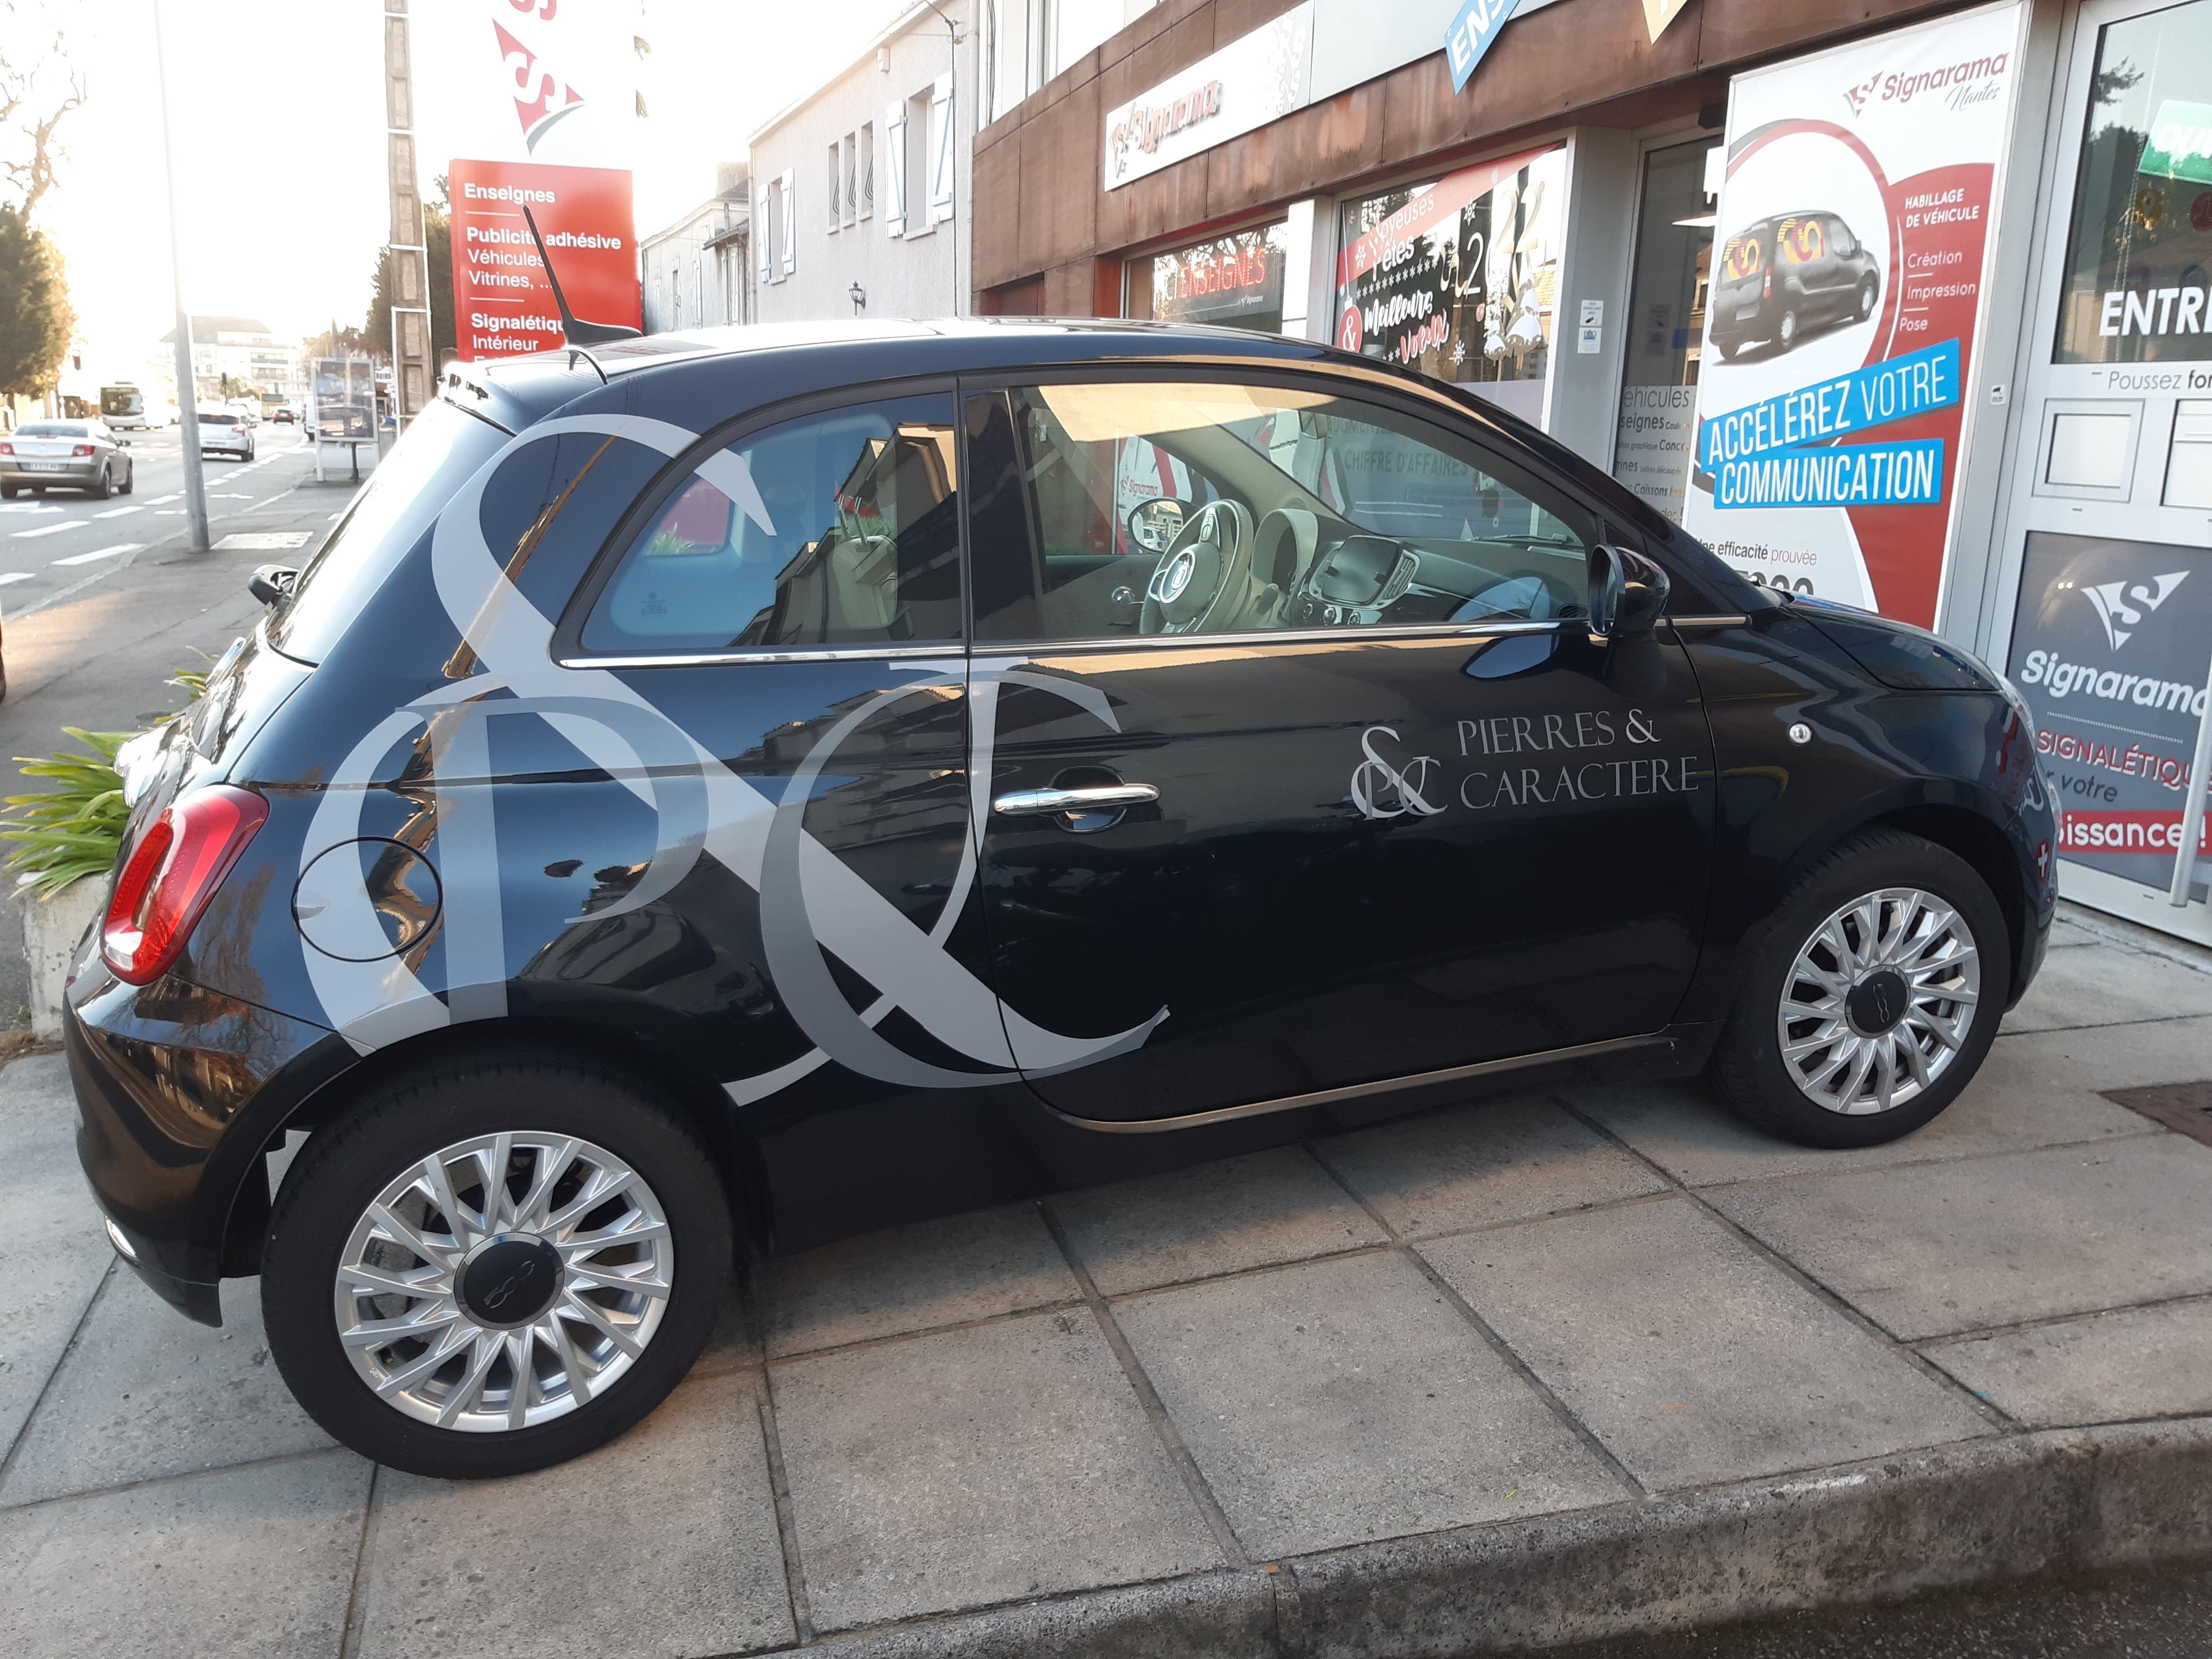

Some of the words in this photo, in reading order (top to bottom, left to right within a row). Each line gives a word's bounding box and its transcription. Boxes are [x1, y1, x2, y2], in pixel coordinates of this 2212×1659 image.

[1882, 52, 2009, 103] Signarama
[1945, 80, 2000, 111] Nantes
[465, 182, 555, 205] Enseignes
[1905, 188, 1965, 209] HABILLAGE
[1906, 214, 1920, 228] DE
[1923, 205, 1980, 226] VÉHICULE
[546, 232, 621, 250] adhésive
[1908, 251, 1962, 268] Création
[469, 270, 534, 290] Vitrines,
[1178, 247, 1266, 299] ENSEIGNES
[1907, 282, 1976, 301] Impression
[1364, 289, 1433, 336] Meilleurs
[1899, 317, 1928, 332] Pose
[473, 335, 539, 351] Intérieur
[2108, 371, 2183, 390] Poussez
[1709, 380, 1851, 465] ACCÉLÉREZ
[1861, 355, 1946, 421] VOTRE
[1620, 413, 1664, 433] seignes
[1345, 450, 1392, 472] CHIFFRE
[1396, 452, 1468, 477] D'AFFAIRES
[1721, 449, 1934, 505] COMMUNICATION
[1634, 483, 1668, 496] Caissons
[1718, 541, 1768, 560] efficacité
[1771, 549, 1817, 565] prouvée
[1456, 710, 1615, 756] PIERRES
[1625, 709, 1661, 744] &
[1460, 756, 1699, 809] CARACTERE
[2061, 774, 2118, 803] votre
